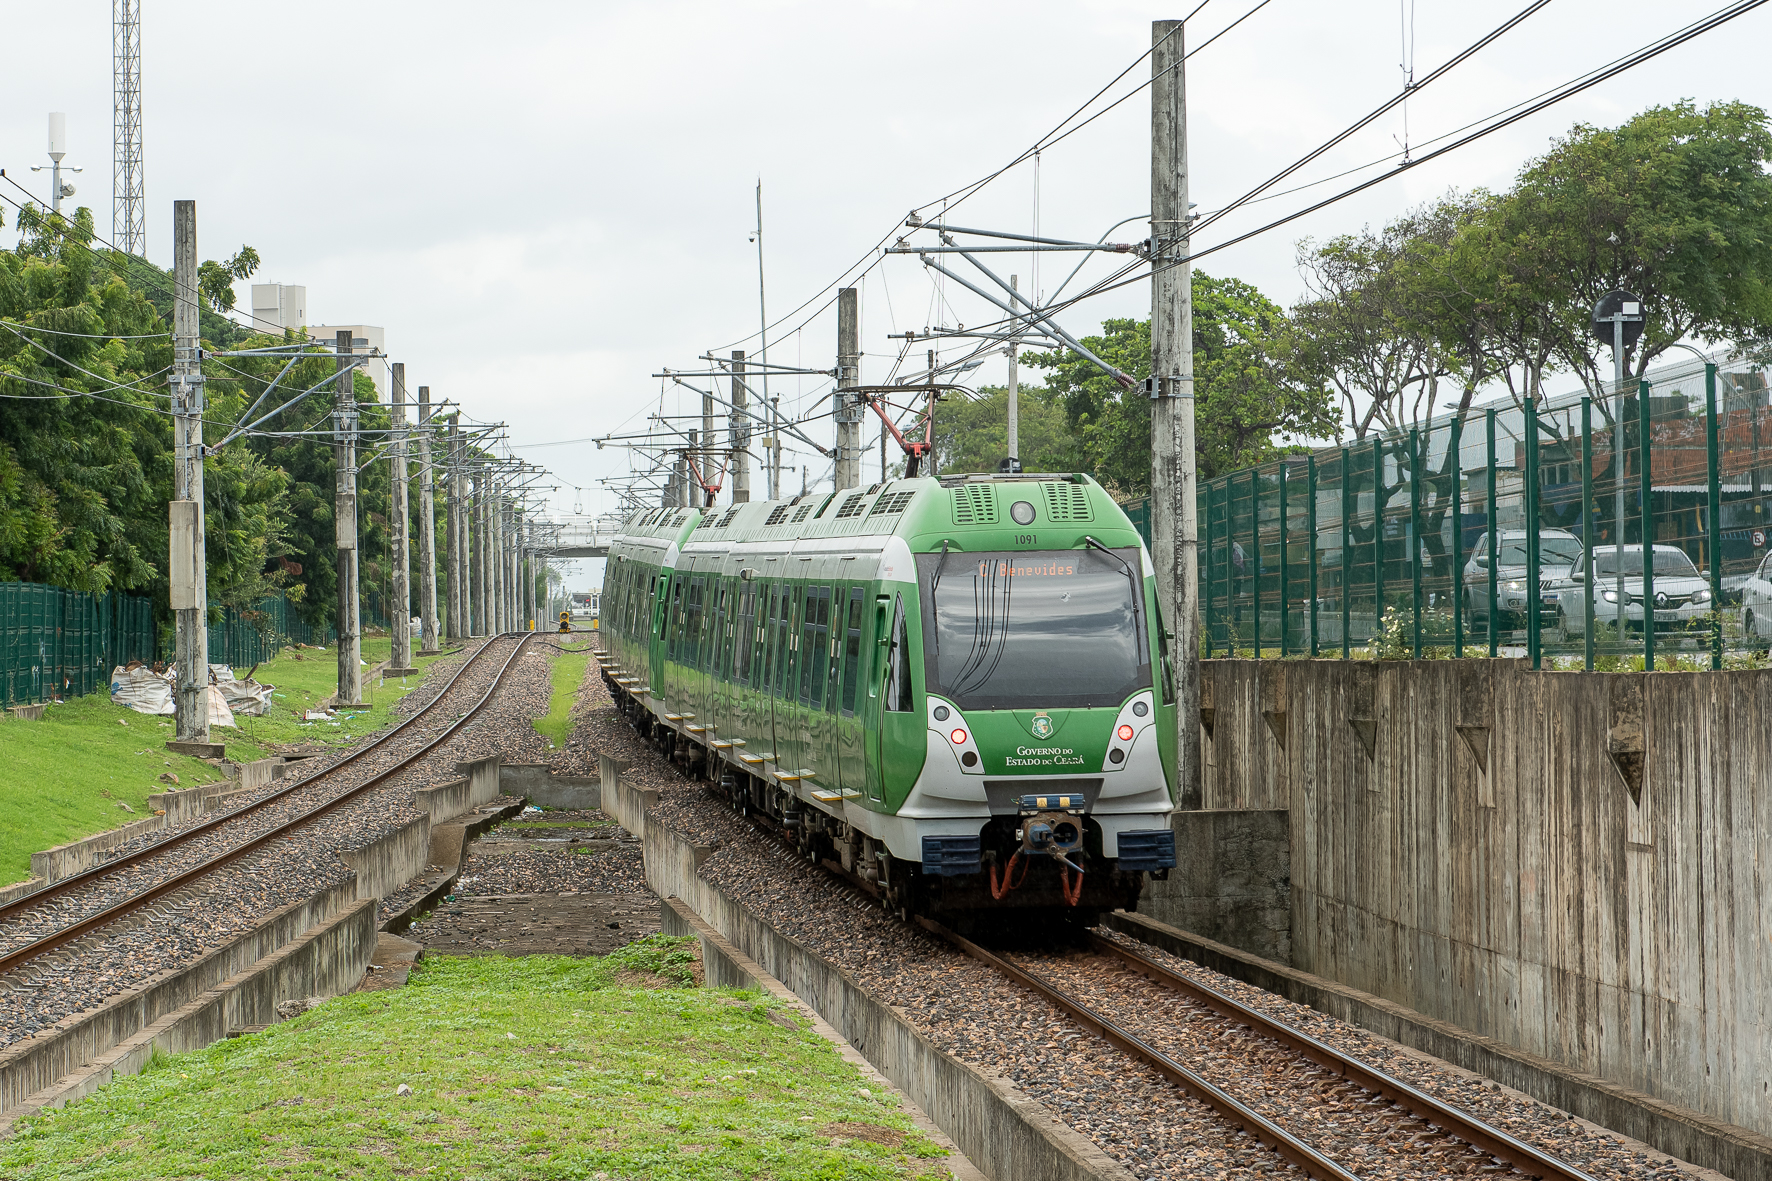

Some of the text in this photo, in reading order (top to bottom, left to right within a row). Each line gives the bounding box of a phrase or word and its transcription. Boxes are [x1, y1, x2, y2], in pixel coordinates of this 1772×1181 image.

[1014, 534, 1037, 545] 1091
[999, 562, 1073, 577] Benevides
[1016, 746, 1061, 756] GOVERNO
[1005, 756, 1041, 766] ESTADO
